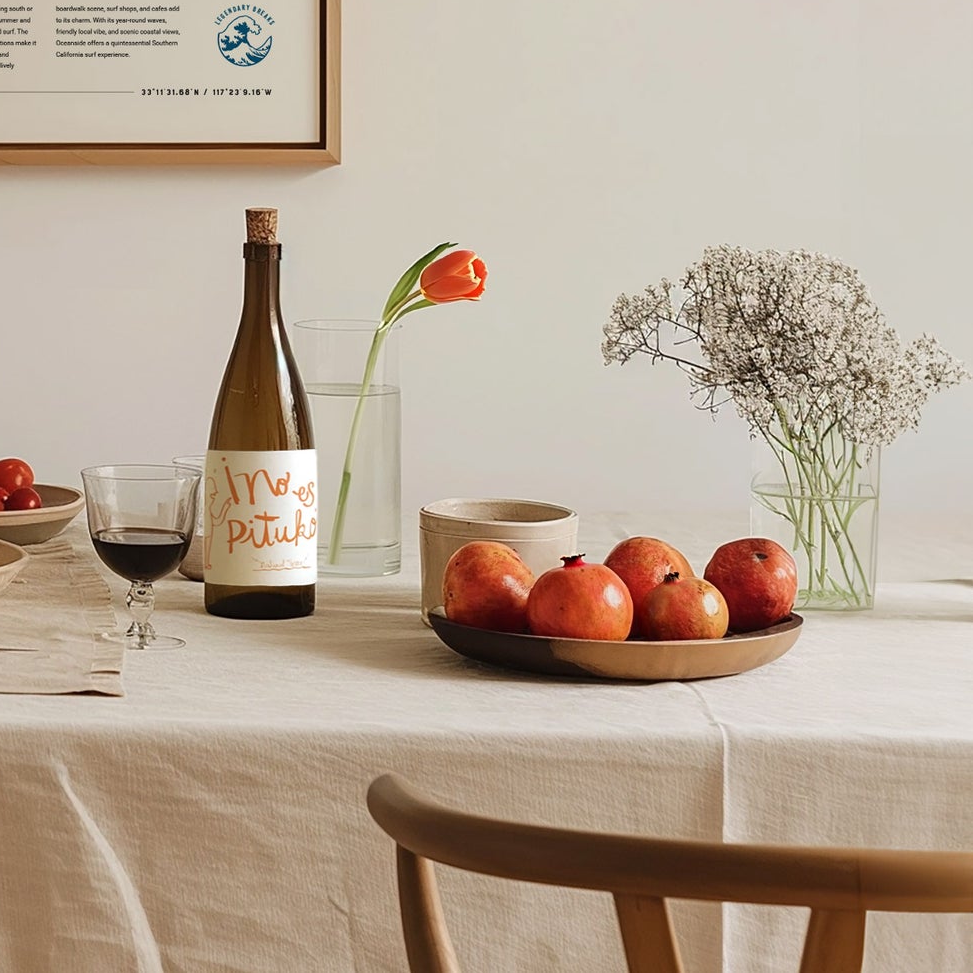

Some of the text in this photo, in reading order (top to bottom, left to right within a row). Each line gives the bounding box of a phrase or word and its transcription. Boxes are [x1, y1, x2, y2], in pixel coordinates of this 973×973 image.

[214, 4, 250, 25] LEGENDARY
[115, 17, 147, 25] year-round
[55, 28, 78, 37] friendly
[110, 39, 151, 48] quintessential
[0, 62, 15, 70] lively
